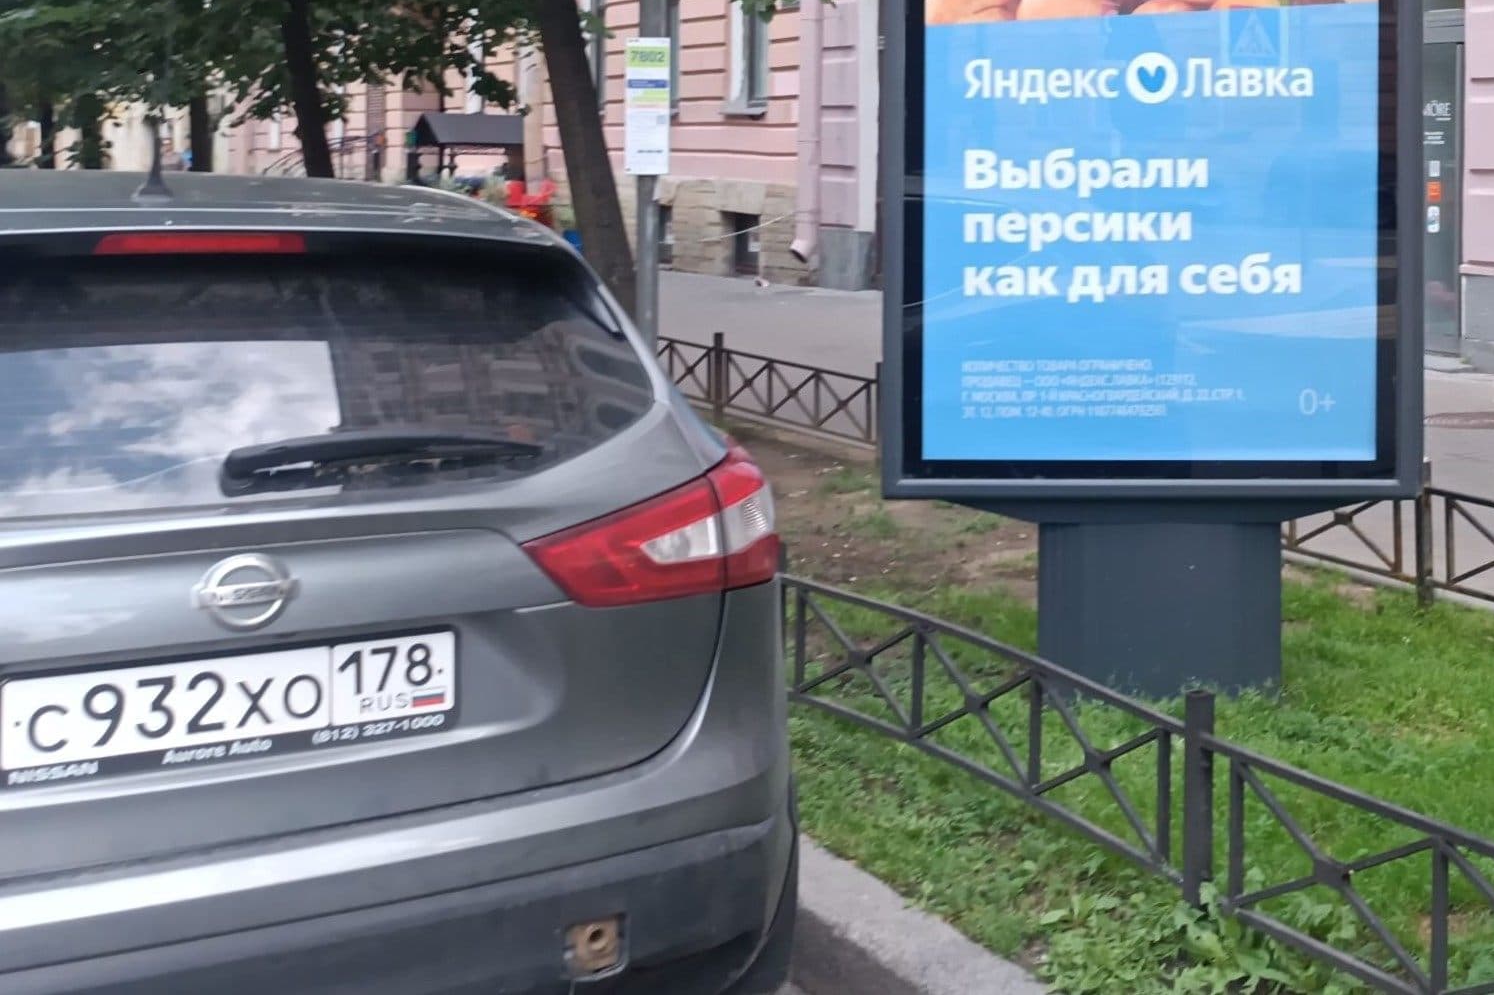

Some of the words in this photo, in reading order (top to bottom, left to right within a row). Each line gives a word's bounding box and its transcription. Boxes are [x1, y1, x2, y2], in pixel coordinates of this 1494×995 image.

[965, 59, 1120, 103] Яндекс
[1181, 58, 1314, 98] Лавка
[964, 148, 1208, 197] Выбрали
[964, 212, 1192, 251] персики
[963, 264, 1058, 296] как
[1067, 264, 1168, 303] для
[1180, 253, 1301, 294] себя
[1299, 389, 1336, 415] 0+
[338, 643, 432, 696] 178
[359, 691, 409, 715] RUS
